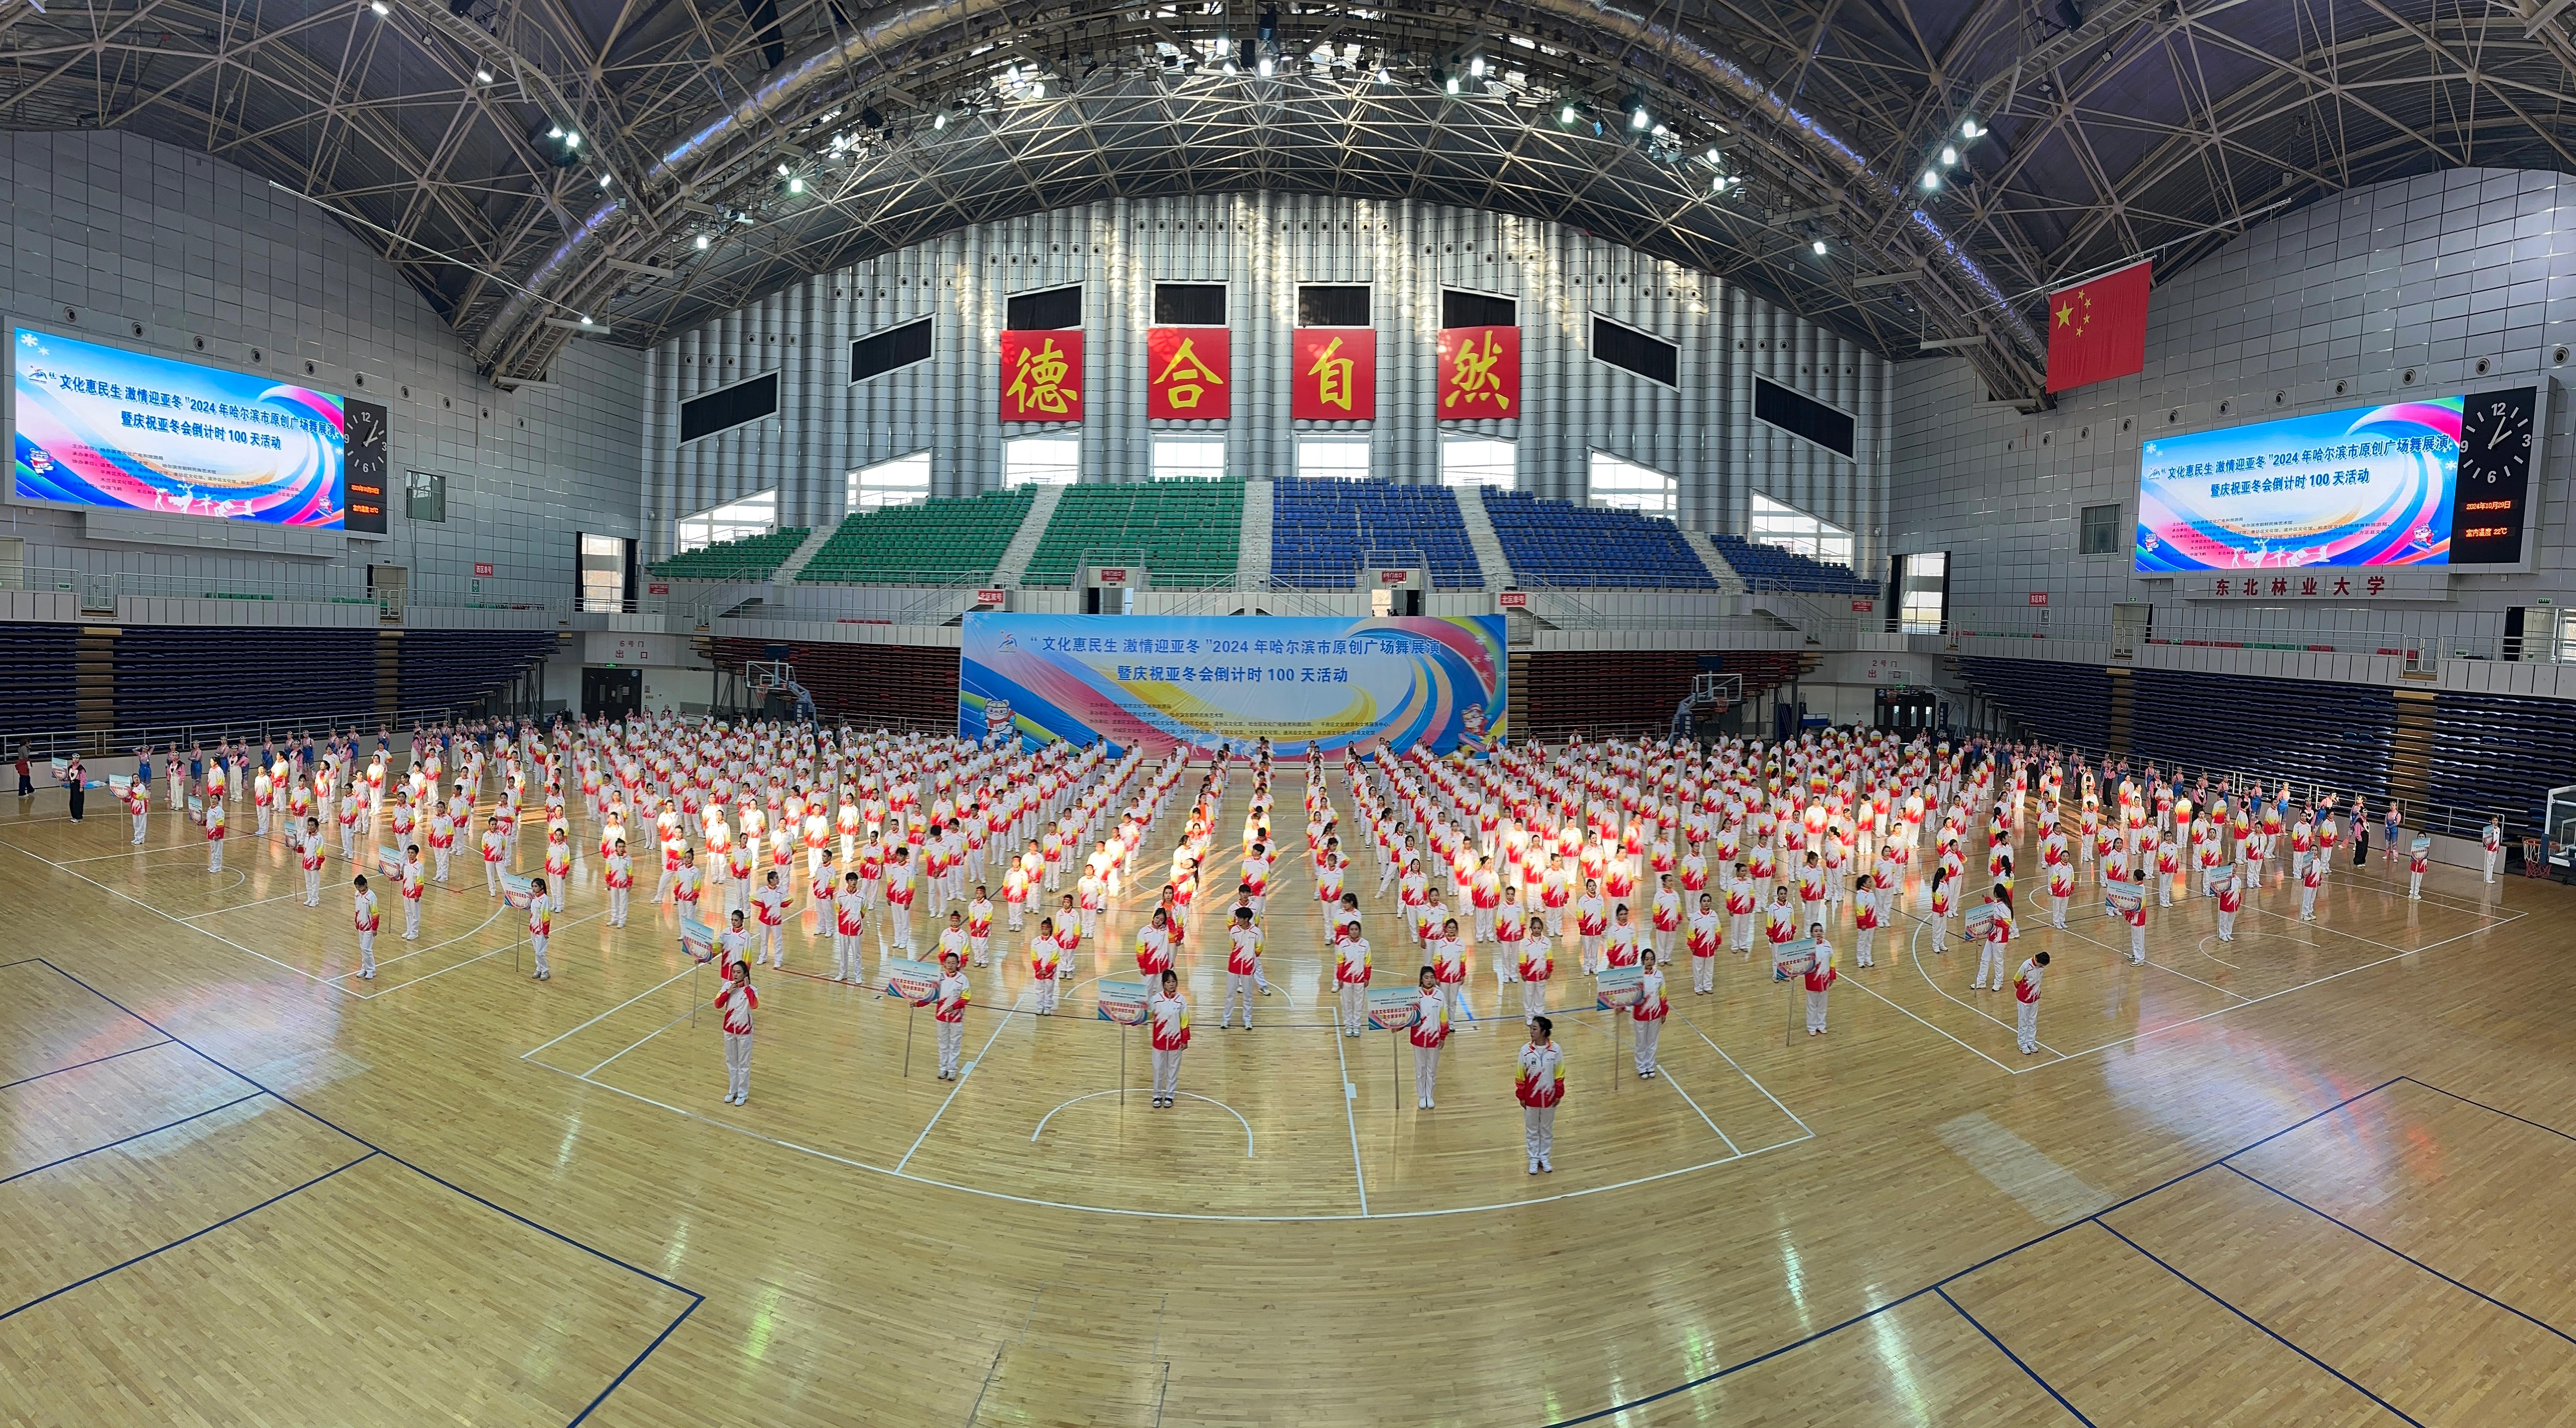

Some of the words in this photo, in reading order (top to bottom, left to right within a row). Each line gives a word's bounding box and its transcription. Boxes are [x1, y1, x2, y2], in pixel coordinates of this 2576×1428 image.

[2491, 402, 2506, 416] 12
[361, 412, 371, 423] 12
[122, 411, 224, 441] 暨庆祝亚冬会倒计时
[229, 430, 247, 444] 100
[250, 432, 282, 450] 天活动
[344, 434, 350, 444] 9
[2522, 434, 2532, 447] 3
[382, 441, 387, 451] 3
[2460, 440, 2469, 453] 9
[363, 463, 369, 473] 6
[2487, 471, 2497, 483] 6
[2211, 474, 2306, 498] 暨庆祝亚冬会倒计时
[2310, 473, 2330, 486] 100
[2333, 468, 2370, 485] 天活动
[2466, 501, 2511, 510] 2024年10月29日
[2466, 528, 2491, 537] 室内温度
[2216, 576, 2385, 596] 东北林业大学
[1501, 595, 1525, 604] 北区单号
[2031, 595, 2046, 603] 东区双号
[615, 650, 648, 659] 出口
[1118, 665, 1262, 683] 暨庆祝亚冬会倒计时
[1268, 668, 1294, 682] 100
[1301, 667, 1348, 683] 天活动
[1868, 670, 1901, 679] 出口
